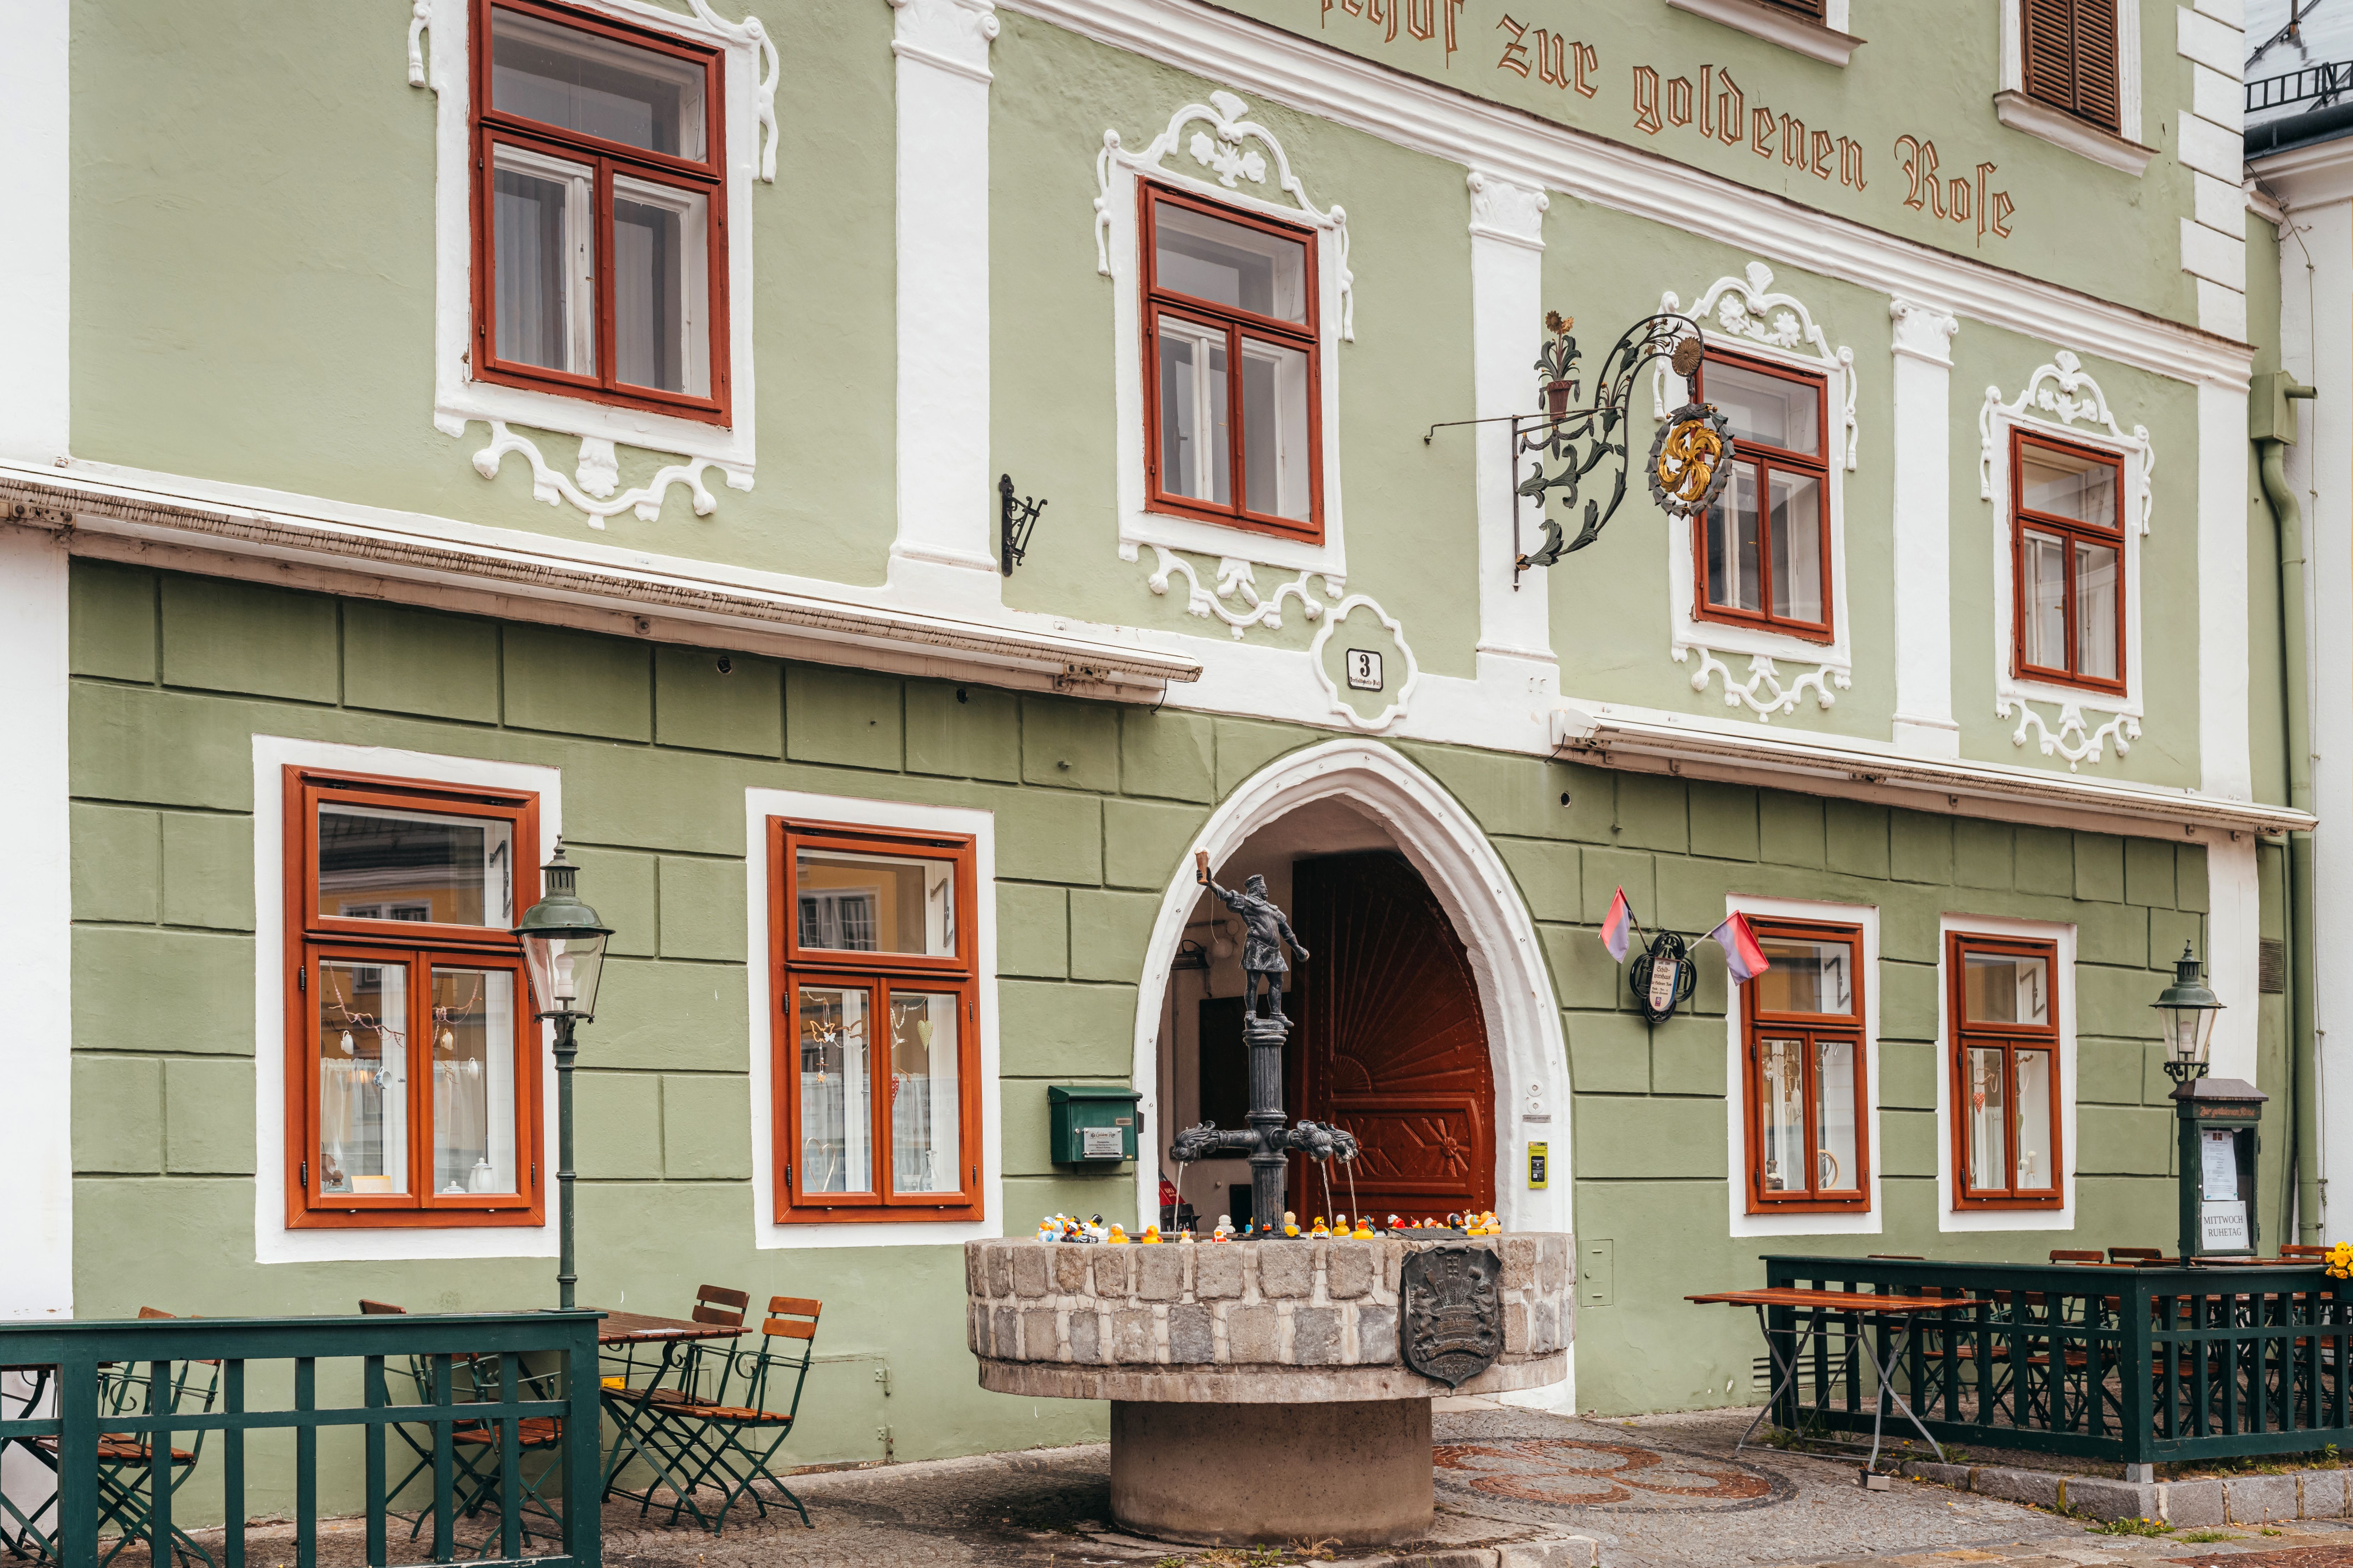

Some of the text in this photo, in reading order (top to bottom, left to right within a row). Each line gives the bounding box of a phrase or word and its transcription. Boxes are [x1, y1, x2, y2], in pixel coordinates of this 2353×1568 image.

[1496, 13, 1598, 99] zur
[1632, 64, 1868, 192] goldenen
[1360, 654, 1370, 677] 3
[2204, 1215, 2243, 1224] MITTWOCH
[2208, 1228, 2242, 1237] RUHETAG
